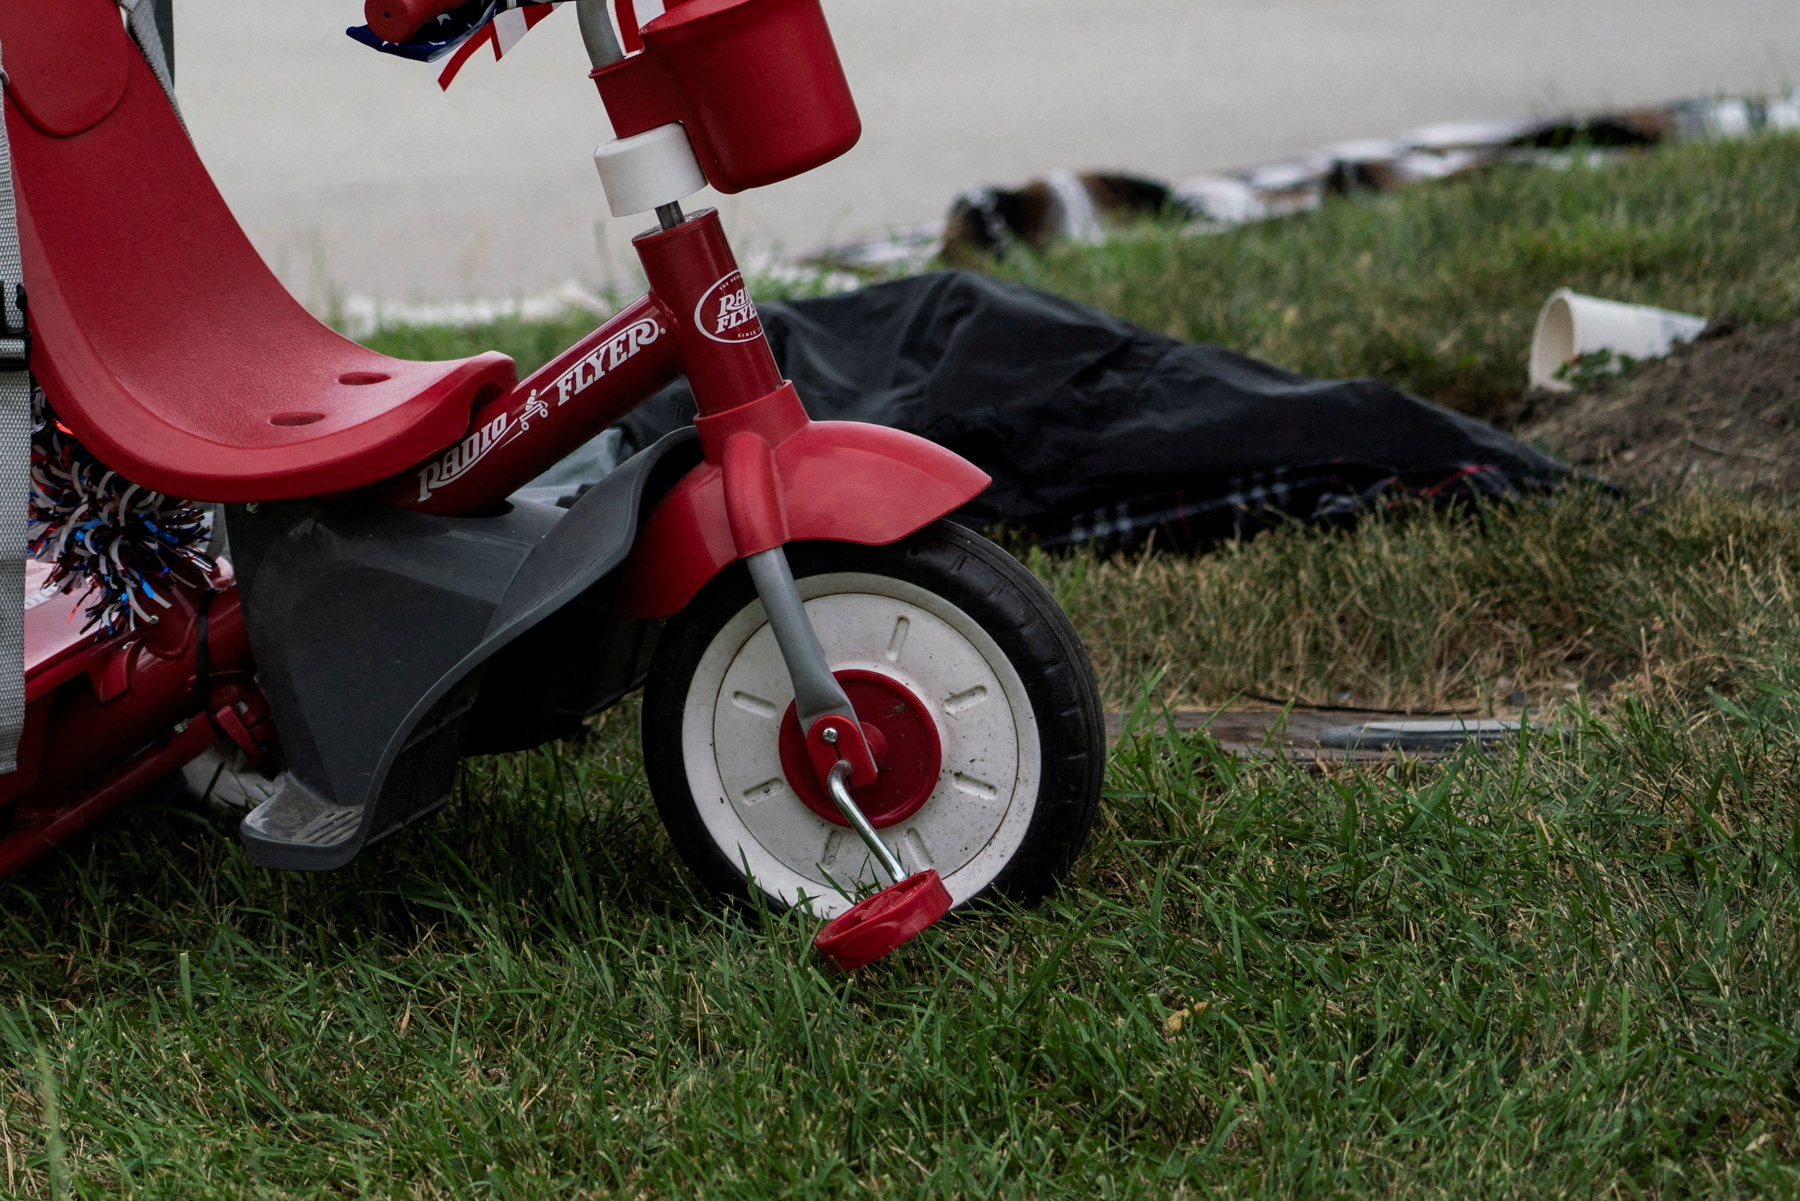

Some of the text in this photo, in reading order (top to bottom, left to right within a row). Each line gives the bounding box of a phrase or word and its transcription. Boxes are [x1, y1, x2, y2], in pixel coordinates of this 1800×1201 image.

[715, 304, 757, 334] FLYE
[417, 318, 659, 502] RADIO FLYER
